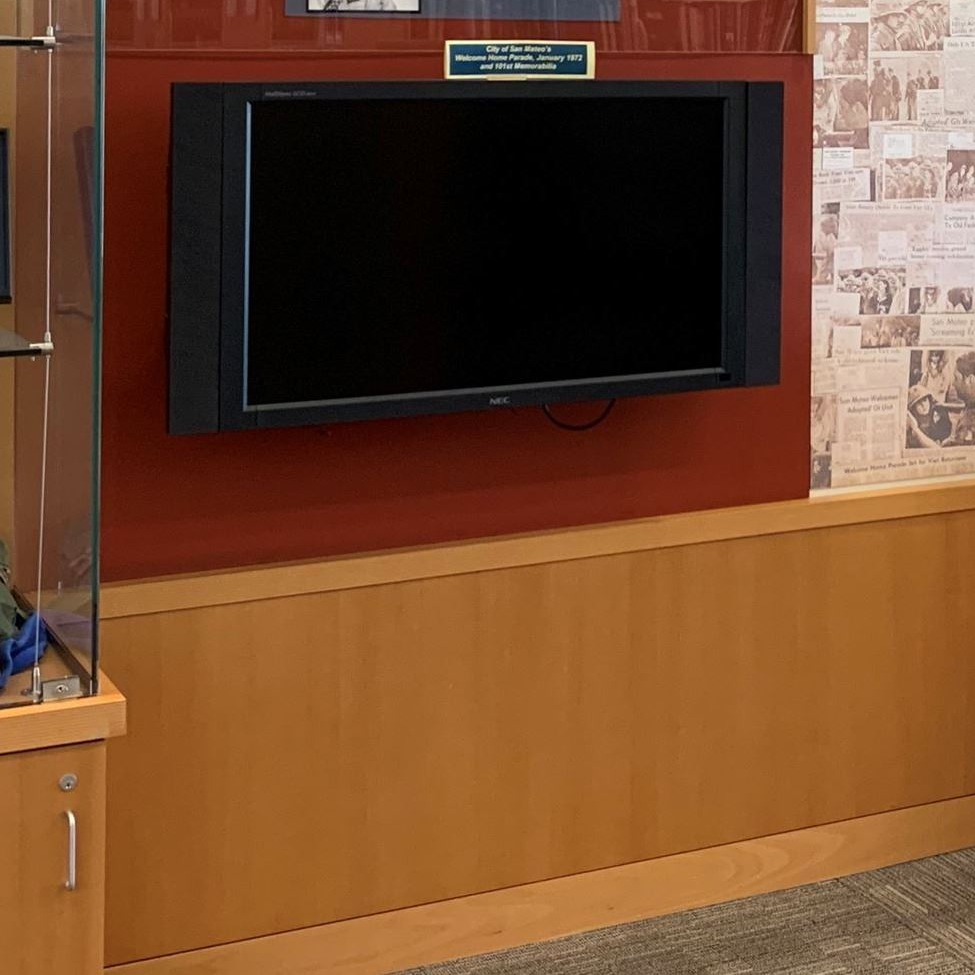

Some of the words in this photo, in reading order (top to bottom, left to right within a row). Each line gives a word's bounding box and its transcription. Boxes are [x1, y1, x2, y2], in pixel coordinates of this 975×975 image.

[486, 45, 499, 54] City
[501, 45, 509, 53] of
[510, 45, 523, 54] San
[524, 45, 552, 54] Mateo's
[536, 54, 565, 64] January
[480, 62, 494, 71] and
[495, 62, 513, 71] 101st
[514, 62, 557, 71] Memorabilia
[489, 396, 511, 406] NEC
